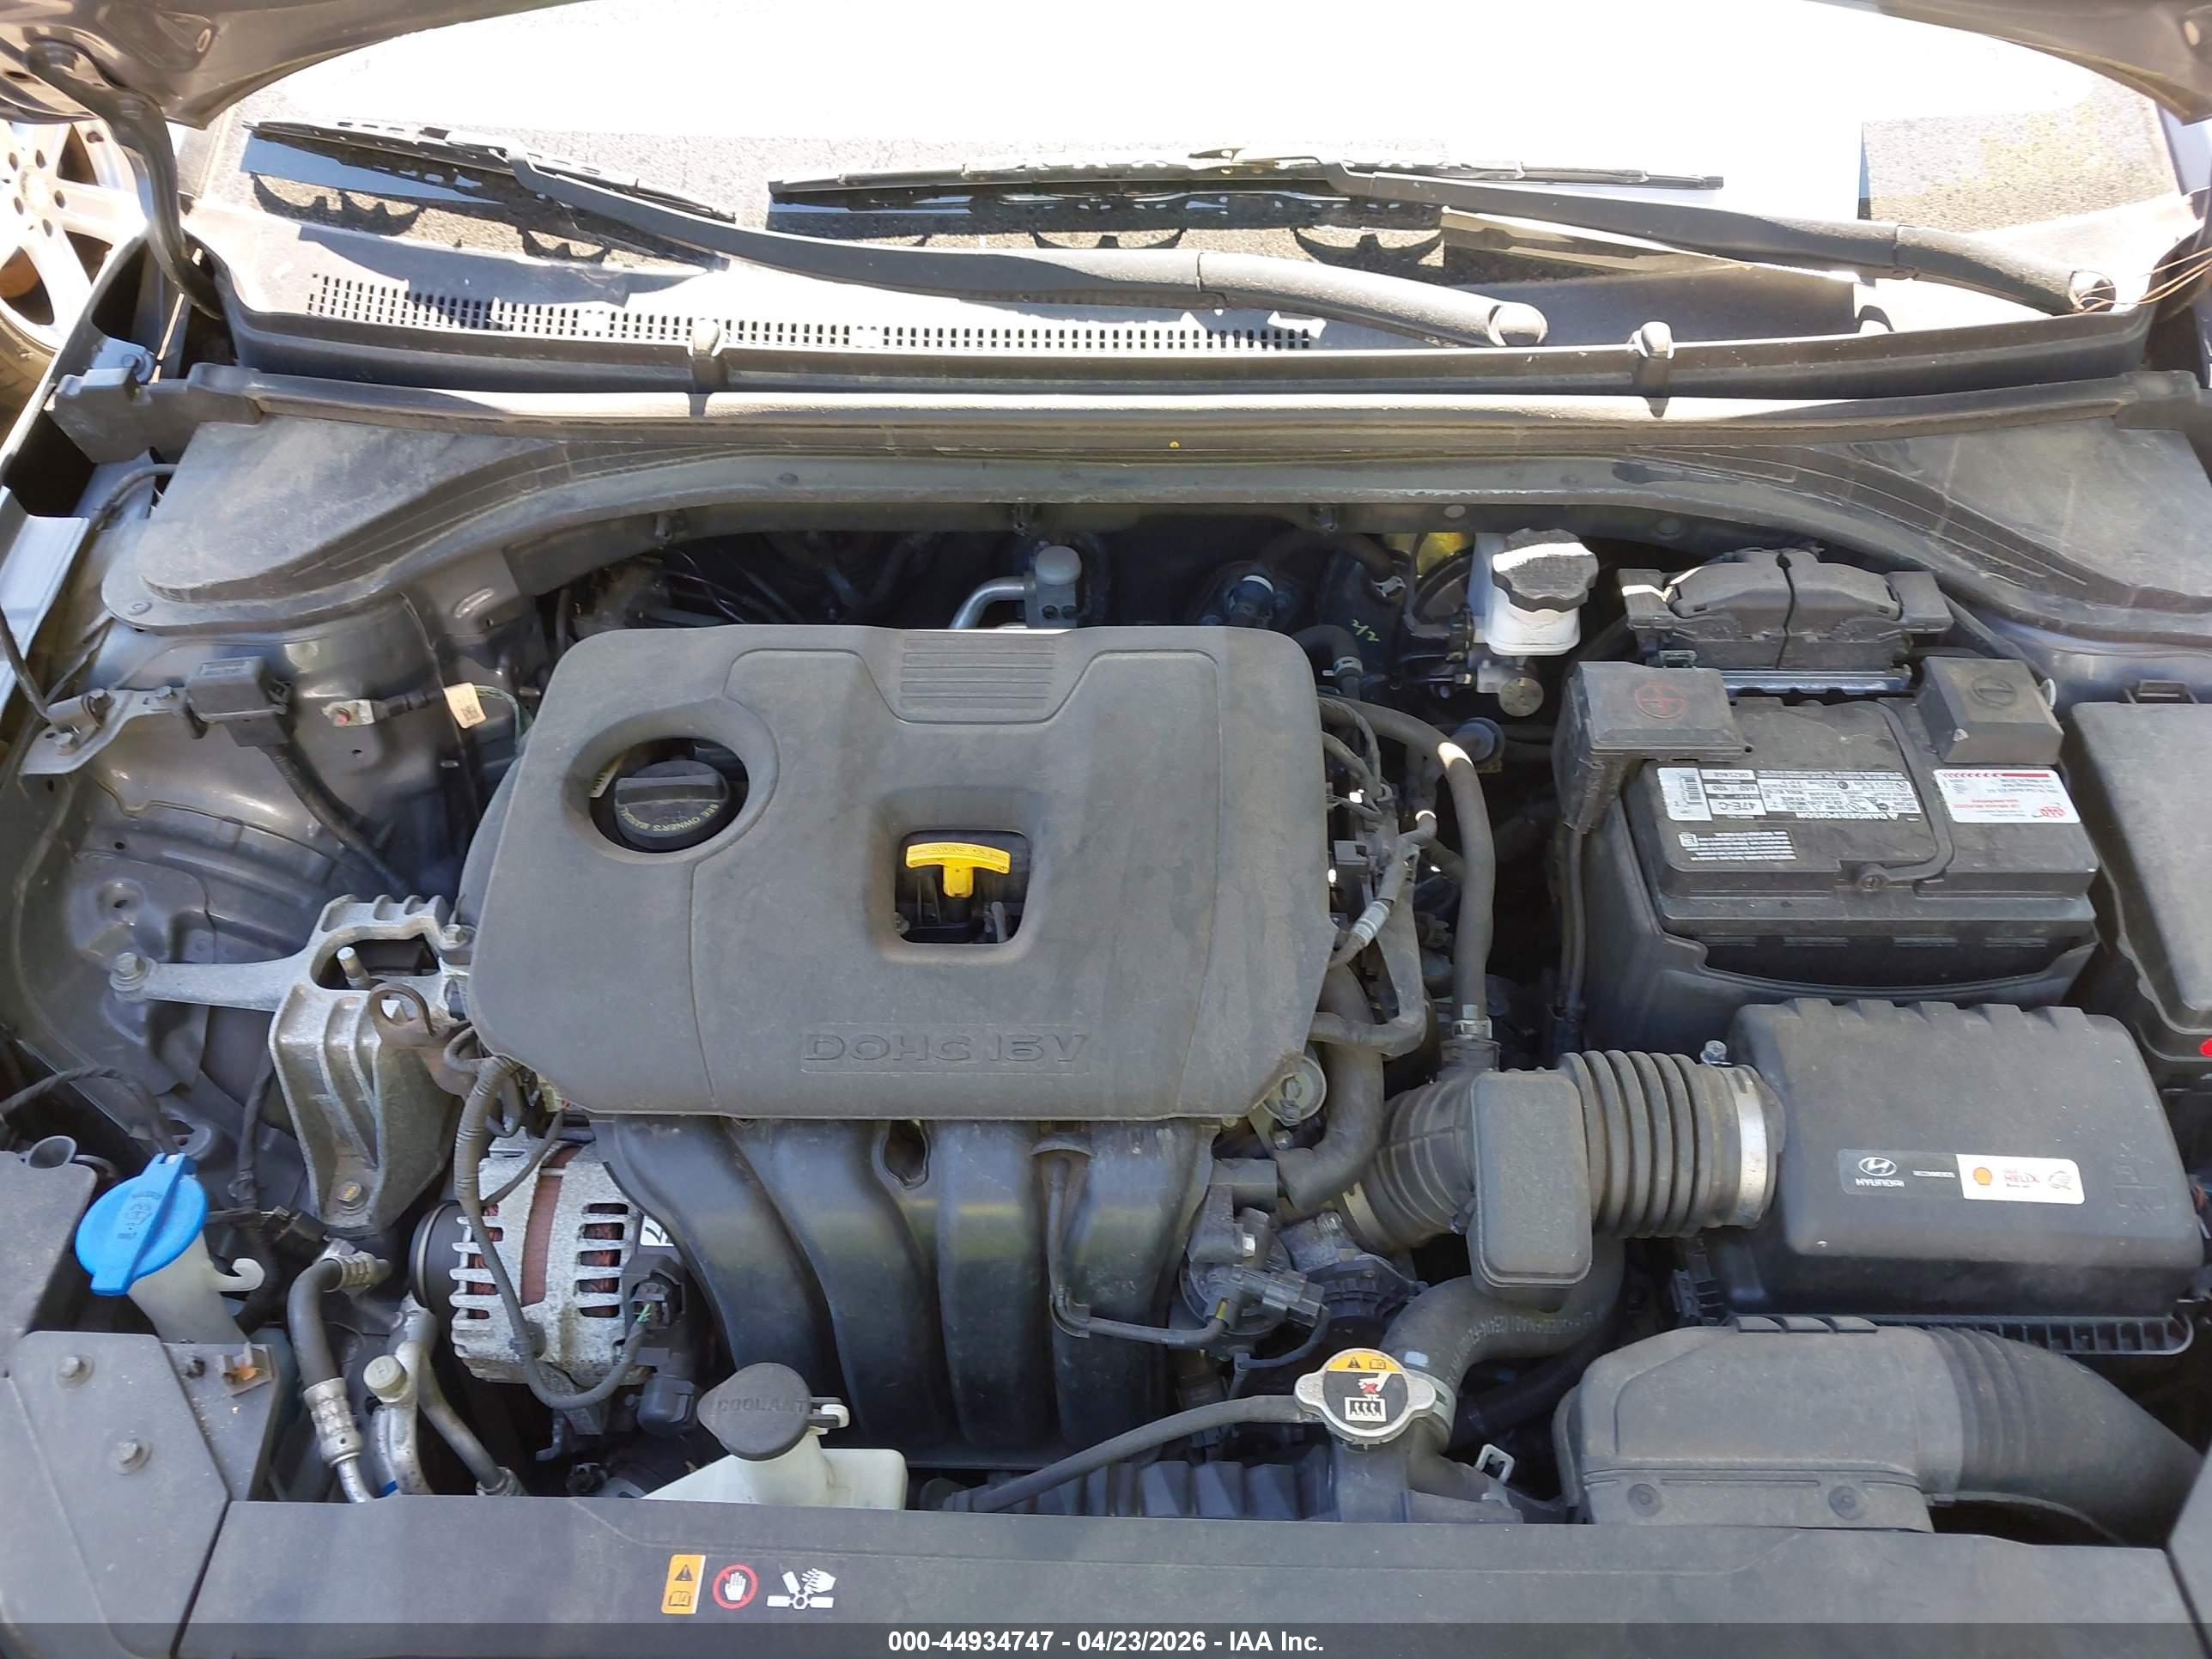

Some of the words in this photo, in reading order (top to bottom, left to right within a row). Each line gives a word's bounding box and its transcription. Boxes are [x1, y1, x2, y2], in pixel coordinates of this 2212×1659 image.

[804, 1033, 974, 1062] DOHC
[988, 1033, 1088, 1062] 16V
[1855, 1177, 1905, 1188] HYUNDAI
[716, 1398, 809, 1414] COOLANT
